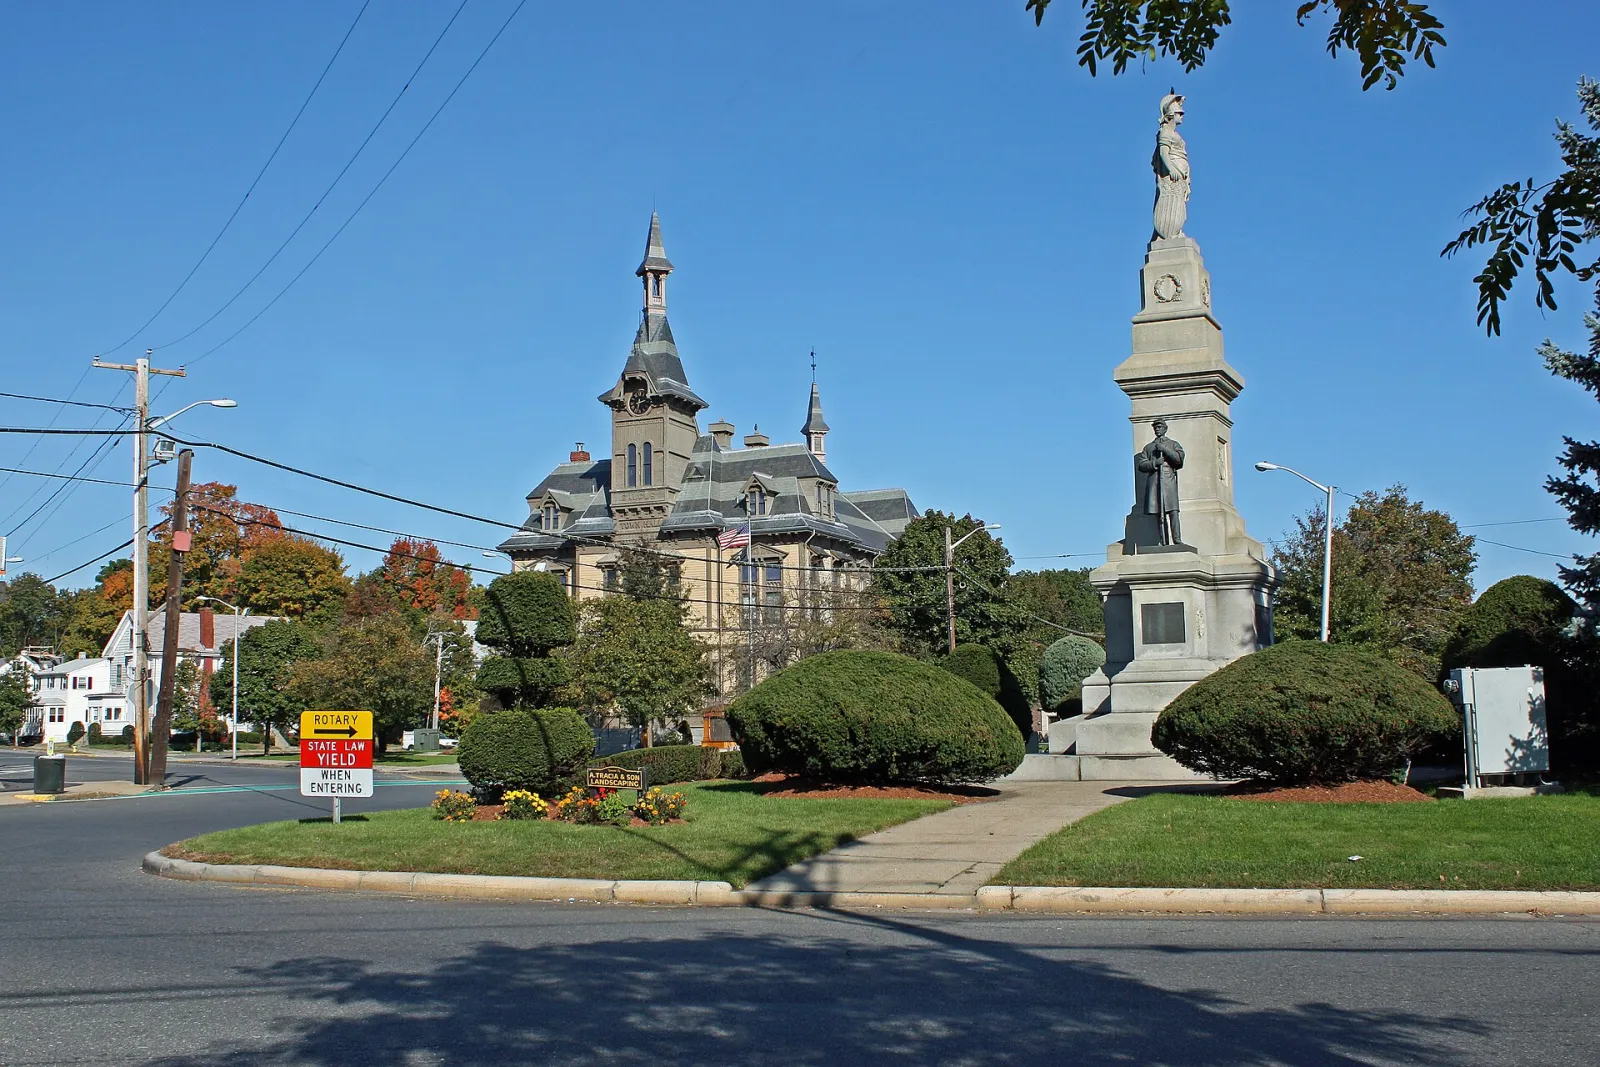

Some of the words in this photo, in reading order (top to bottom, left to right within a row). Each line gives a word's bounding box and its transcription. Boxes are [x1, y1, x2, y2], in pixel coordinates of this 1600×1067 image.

[314, 715, 358, 725] ROTARY
[308, 741, 337, 751] STATE
[344, 742, 365, 751] LAW
[317, 753, 356, 766] YIELD
[321, 770, 351, 780] WHEN
[311, 782, 362, 793] ENTERING
[590, 779, 639, 787] LANDSCAPING
